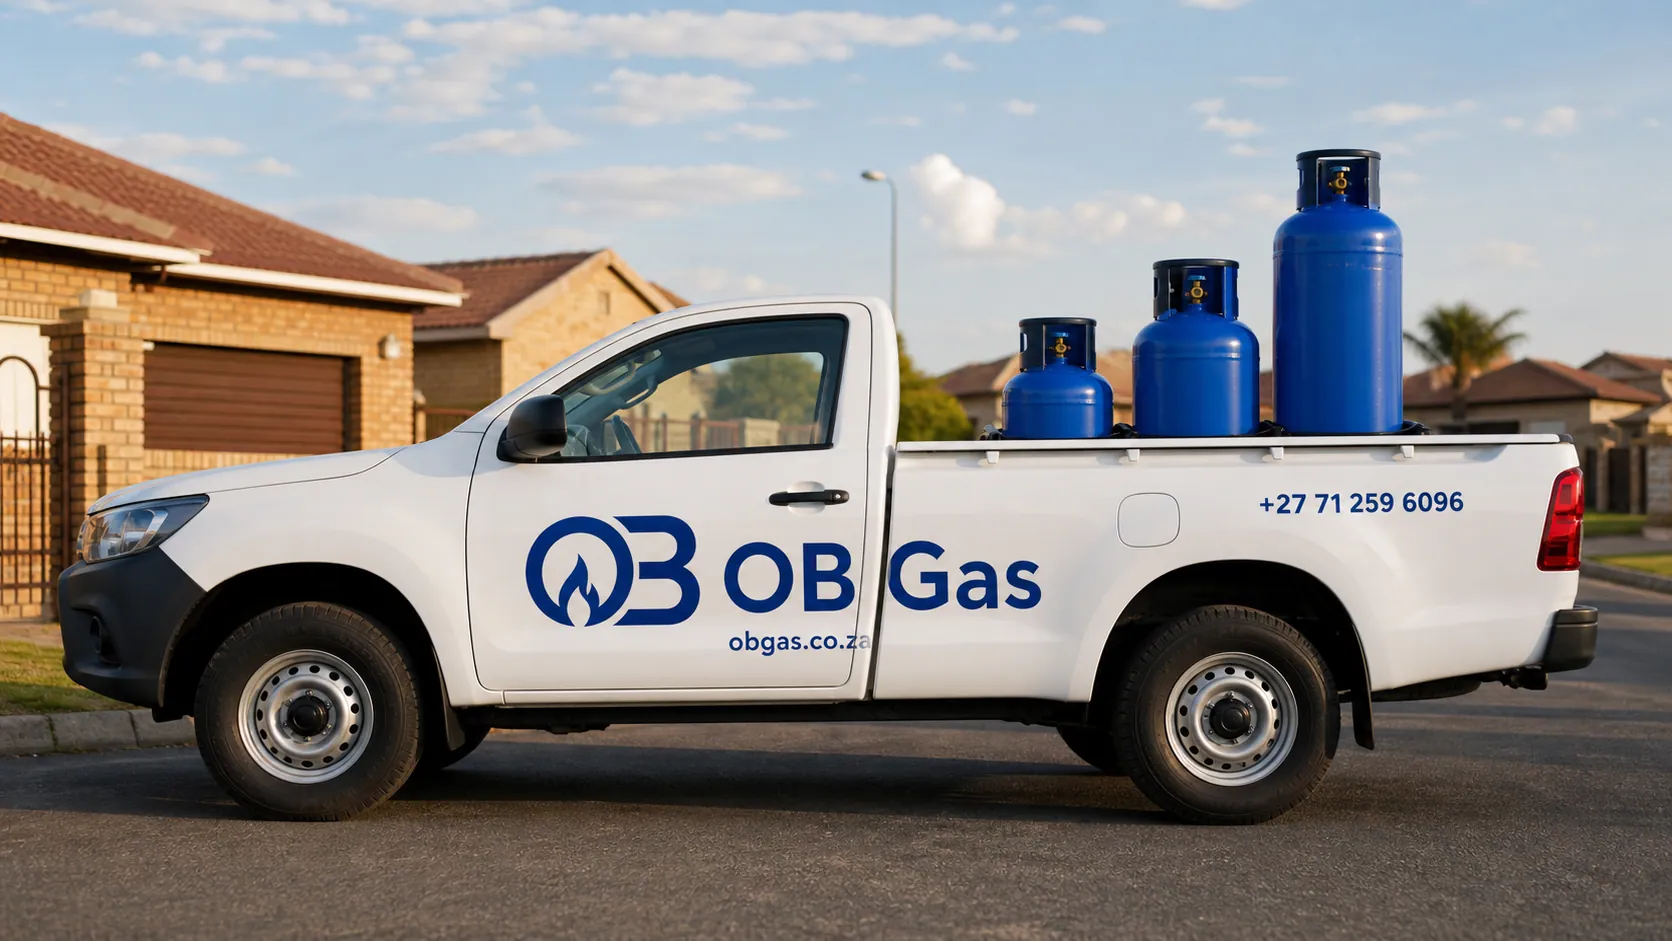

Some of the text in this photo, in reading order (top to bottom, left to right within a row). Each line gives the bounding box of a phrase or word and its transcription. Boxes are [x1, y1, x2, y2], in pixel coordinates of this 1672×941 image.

[1259, 491, 1465, 515] +27 71 259 6096
[724, 540, 1042, 614] OB Gas
[728, 631, 872, 657] obgas.co.za
